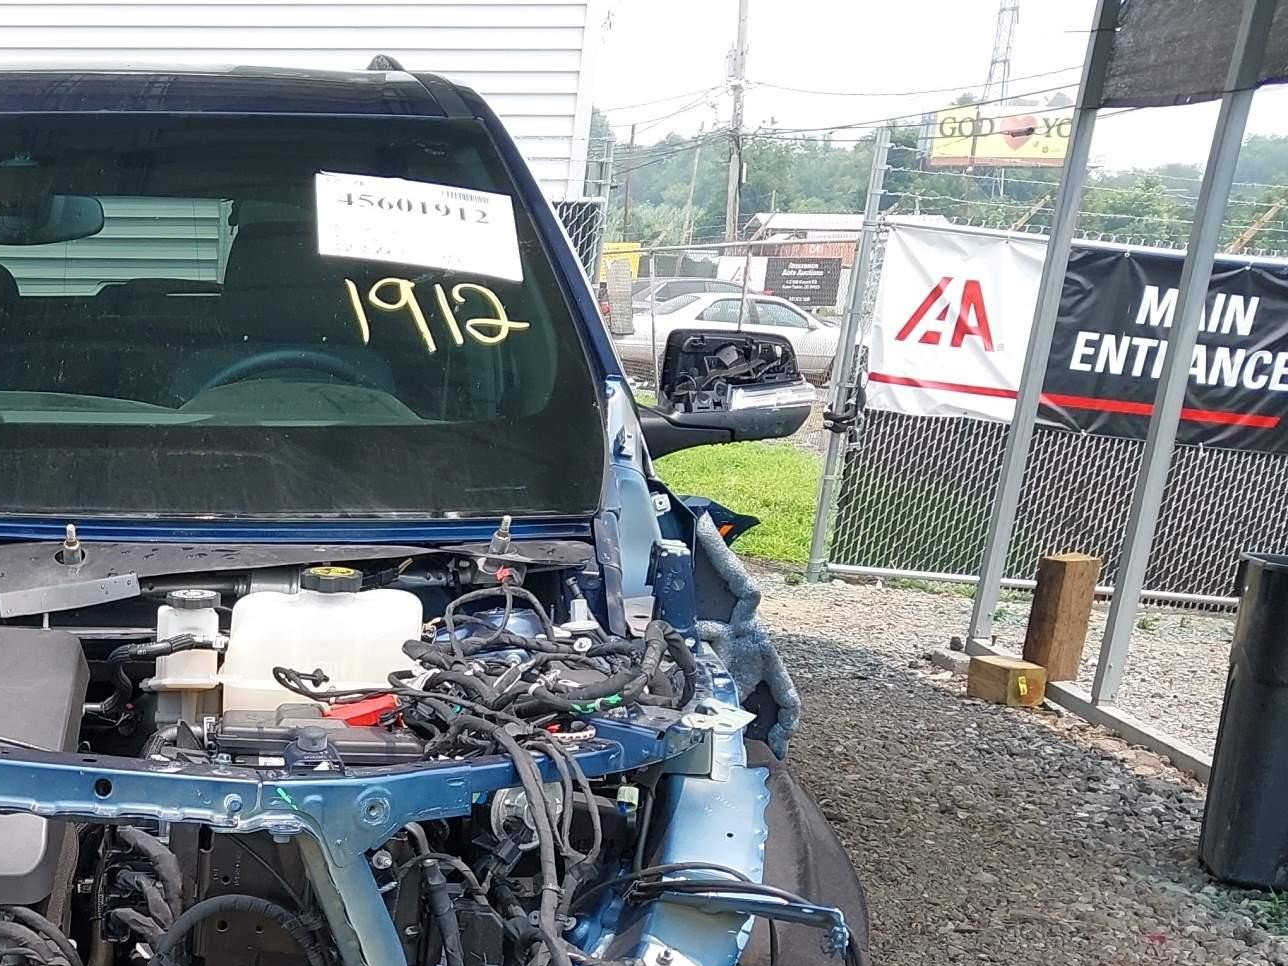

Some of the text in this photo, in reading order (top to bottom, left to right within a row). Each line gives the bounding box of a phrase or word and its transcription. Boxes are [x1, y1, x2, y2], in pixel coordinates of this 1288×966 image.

[939, 116, 1073, 138] GOD YO
[338, 192, 490, 224] 45601912
[344, 277, 531, 353] 1912
[1135, 285, 1260, 336] MIN
